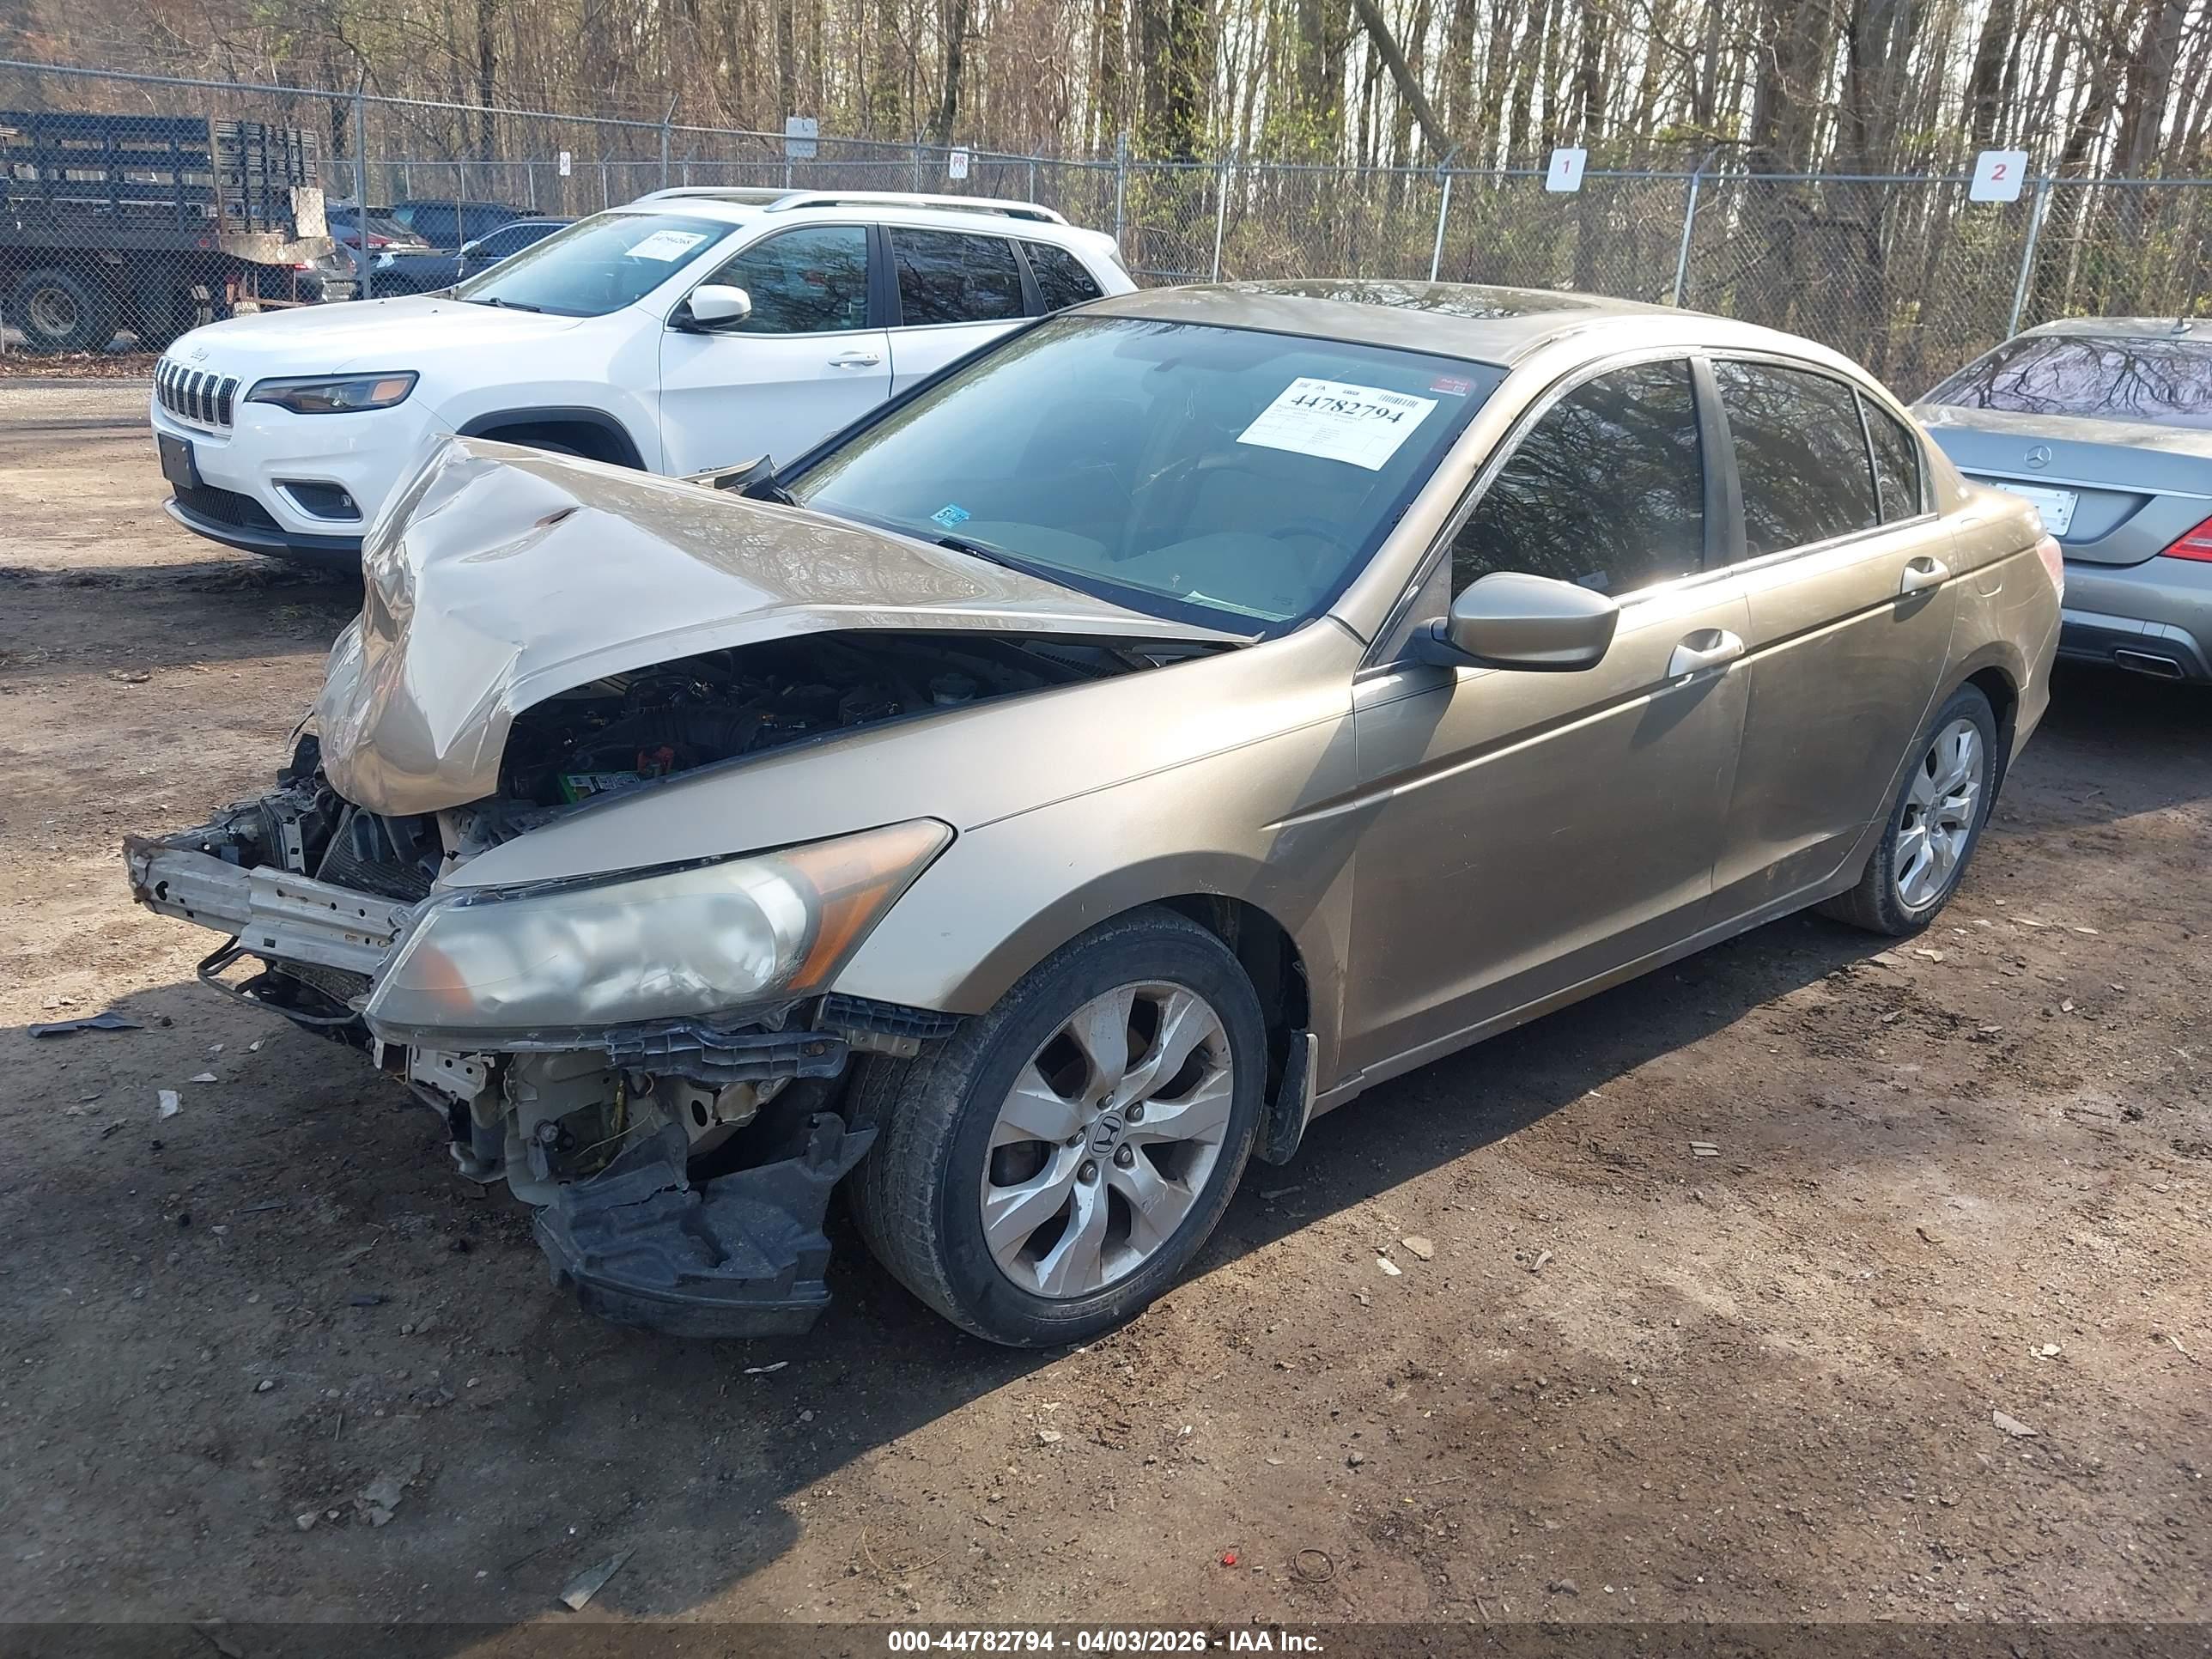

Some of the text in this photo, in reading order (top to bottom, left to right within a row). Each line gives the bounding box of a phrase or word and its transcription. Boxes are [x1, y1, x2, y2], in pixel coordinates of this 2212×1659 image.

[1563, 160, 1571, 174] 1
[1990, 163, 2008, 181] 2
[1291, 394, 1405, 423] 44782794
